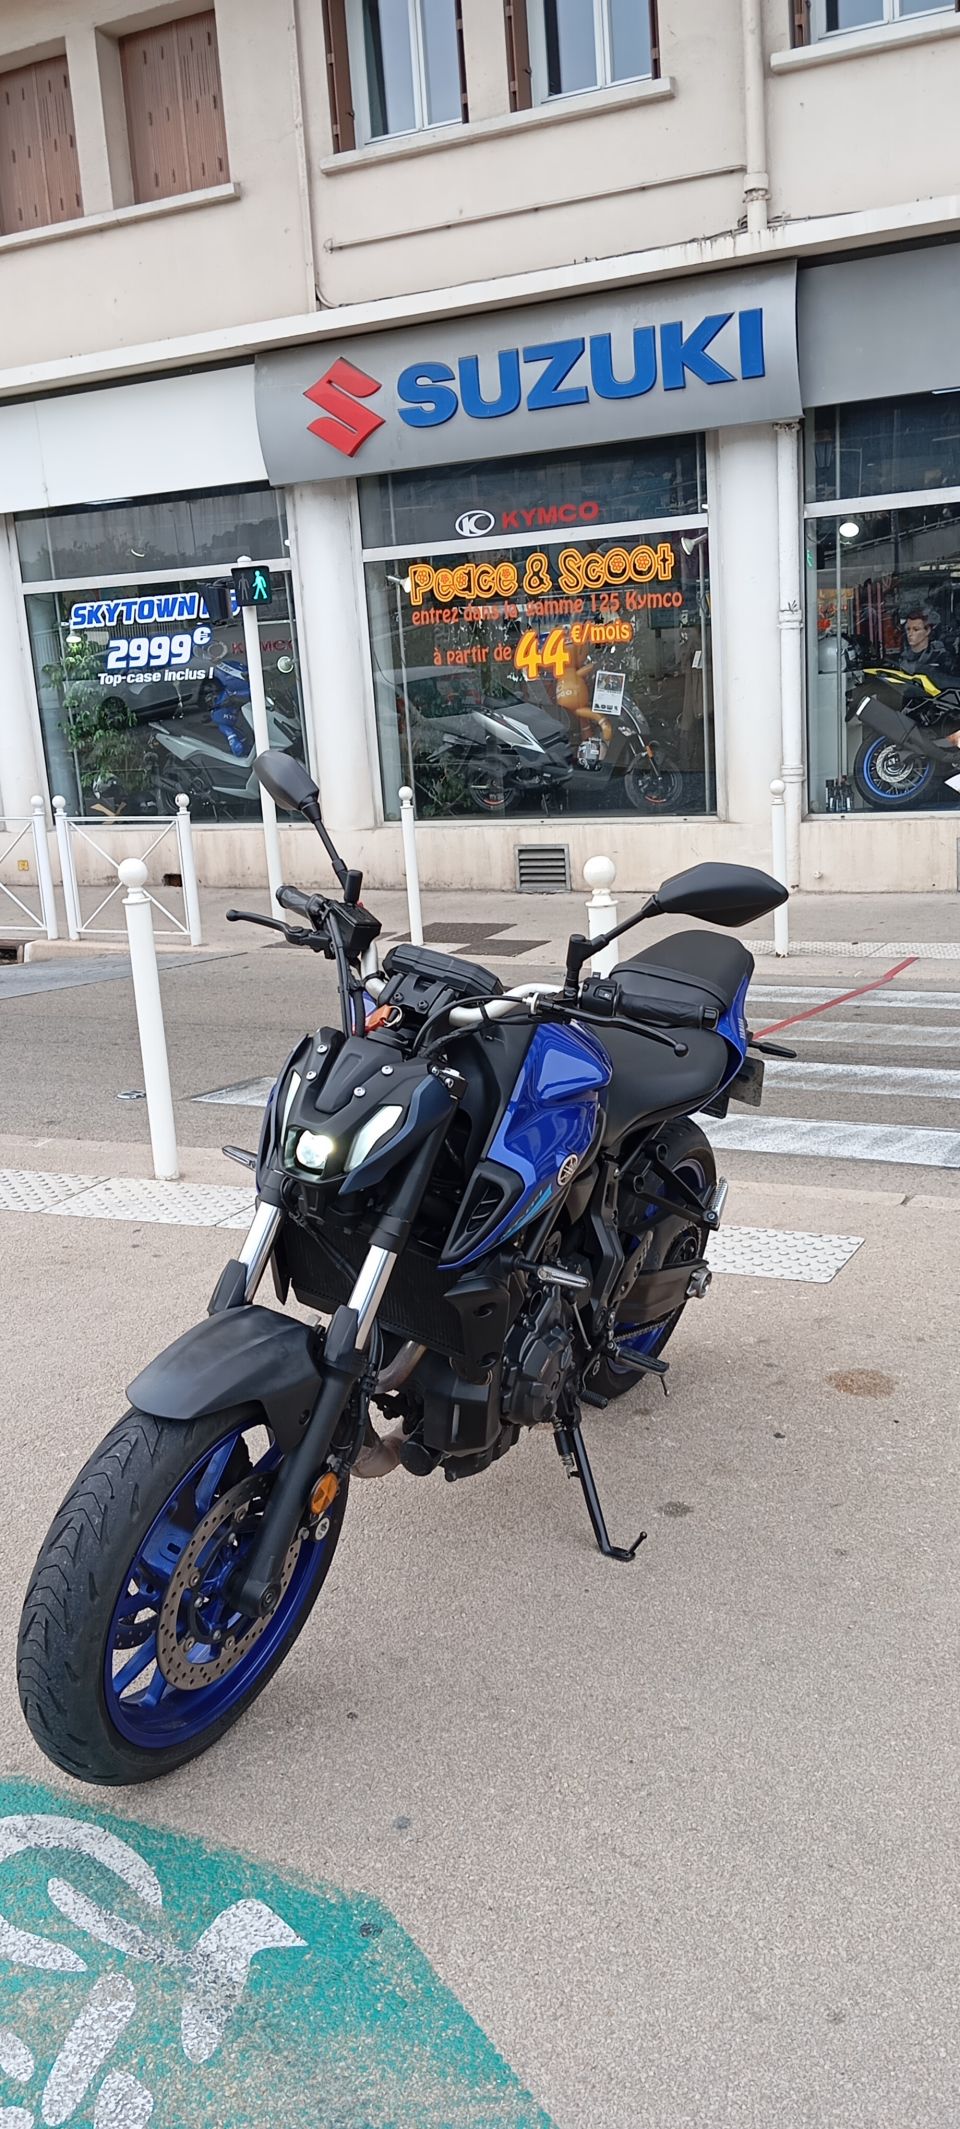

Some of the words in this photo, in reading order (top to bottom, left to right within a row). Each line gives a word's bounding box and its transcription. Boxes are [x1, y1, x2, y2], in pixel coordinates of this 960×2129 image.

[397, 307, 766, 428] SUZUKI
[501, 501, 599, 529] KYMCO
[408, 562, 518, 606] Peace
[522, 552, 552, 595] &
[558, 543, 674, 595] Scoot
[71, 592, 199, 630] SKYTOWN
[411, 606, 459, 626] entrez
[463, 601, 500, 622] dans
[504, 600, 518, 619] la
[591, 592, 620, 613] 125
[625, 590, 683, 611] Kymco
[433, 647, 443, 666] à
[447, 647, 489, 665] partir
[494, 641, 512, 662] de
[98, 671, 161, 687] Top-case
[164, 669, 205, 682] inclus
